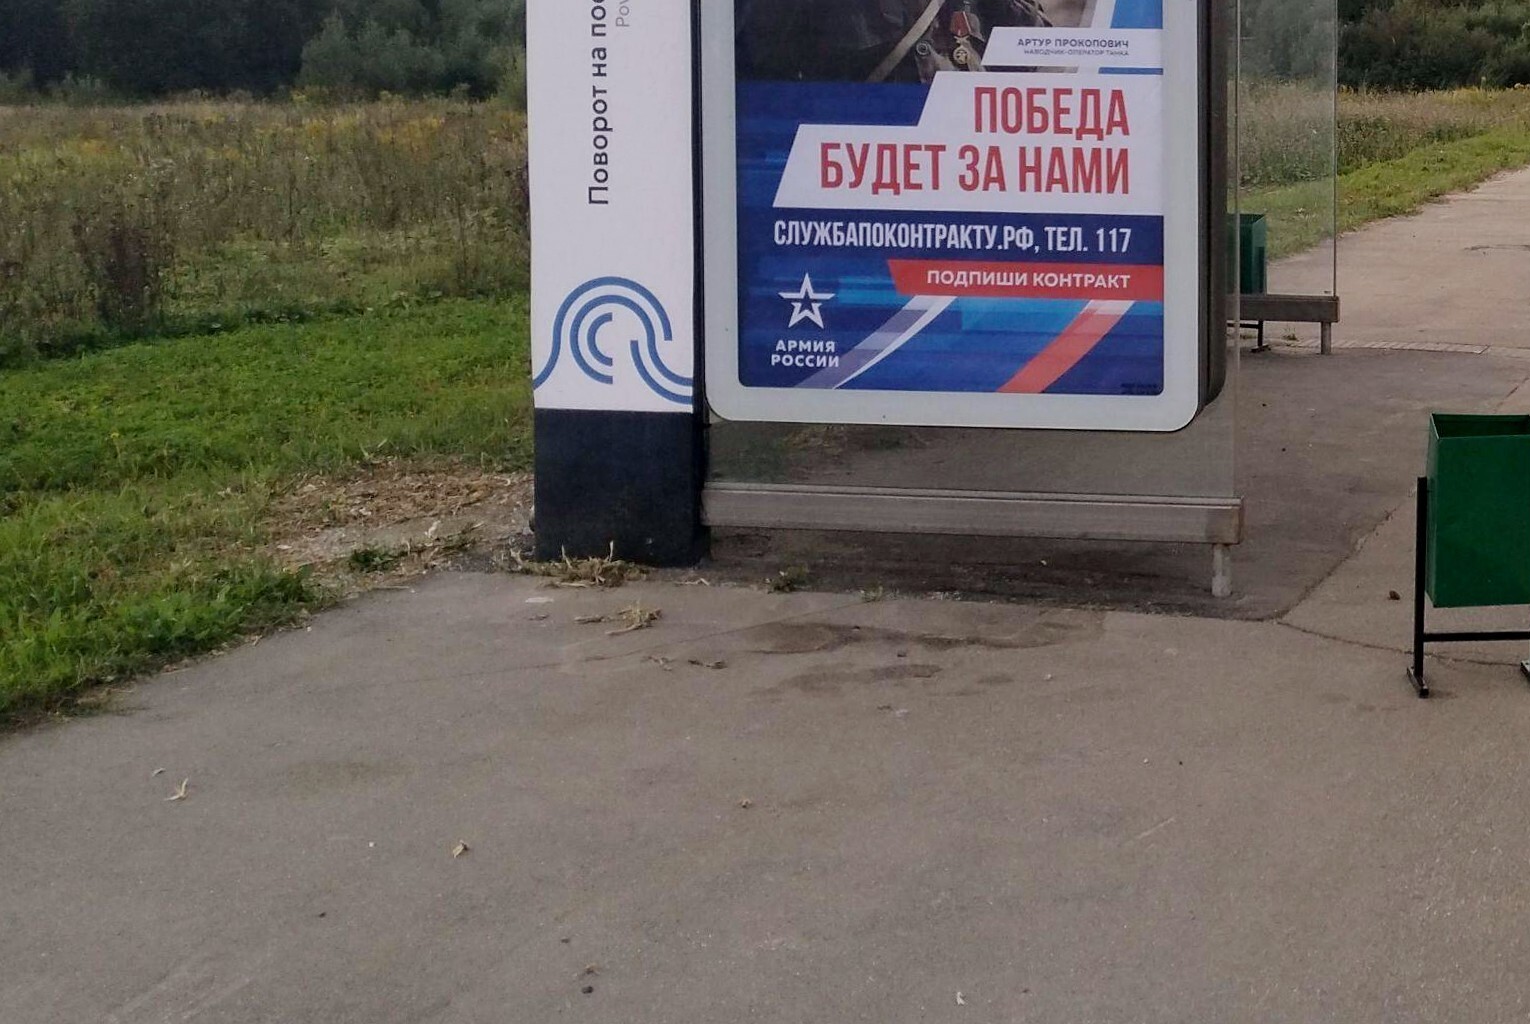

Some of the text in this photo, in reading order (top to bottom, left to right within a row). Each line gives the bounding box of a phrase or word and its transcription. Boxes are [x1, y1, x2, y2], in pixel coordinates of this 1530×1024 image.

[1017, 38, 1129, 49] АРТУР ПРОКОПОВИЧ
[592, 47, 607, 77] на
[974, 86, 1130, 141] ПОБЕДА
[588, 85, 613, 205] Поворот
[820, 142, 1129, 195] БУДЕТ ЗА НАМИ
[773, 220, 1131, 253] СЛУЖБАПОКОНТРАКТУ.РФ, ТЕЛ. 117
[927, 270, 1131, 289] ПОДПИШИ КОНТРАКТ
[775, 339, 836, 352] АРМИЯ
[771, 355, 840, 368] РОССИИ
